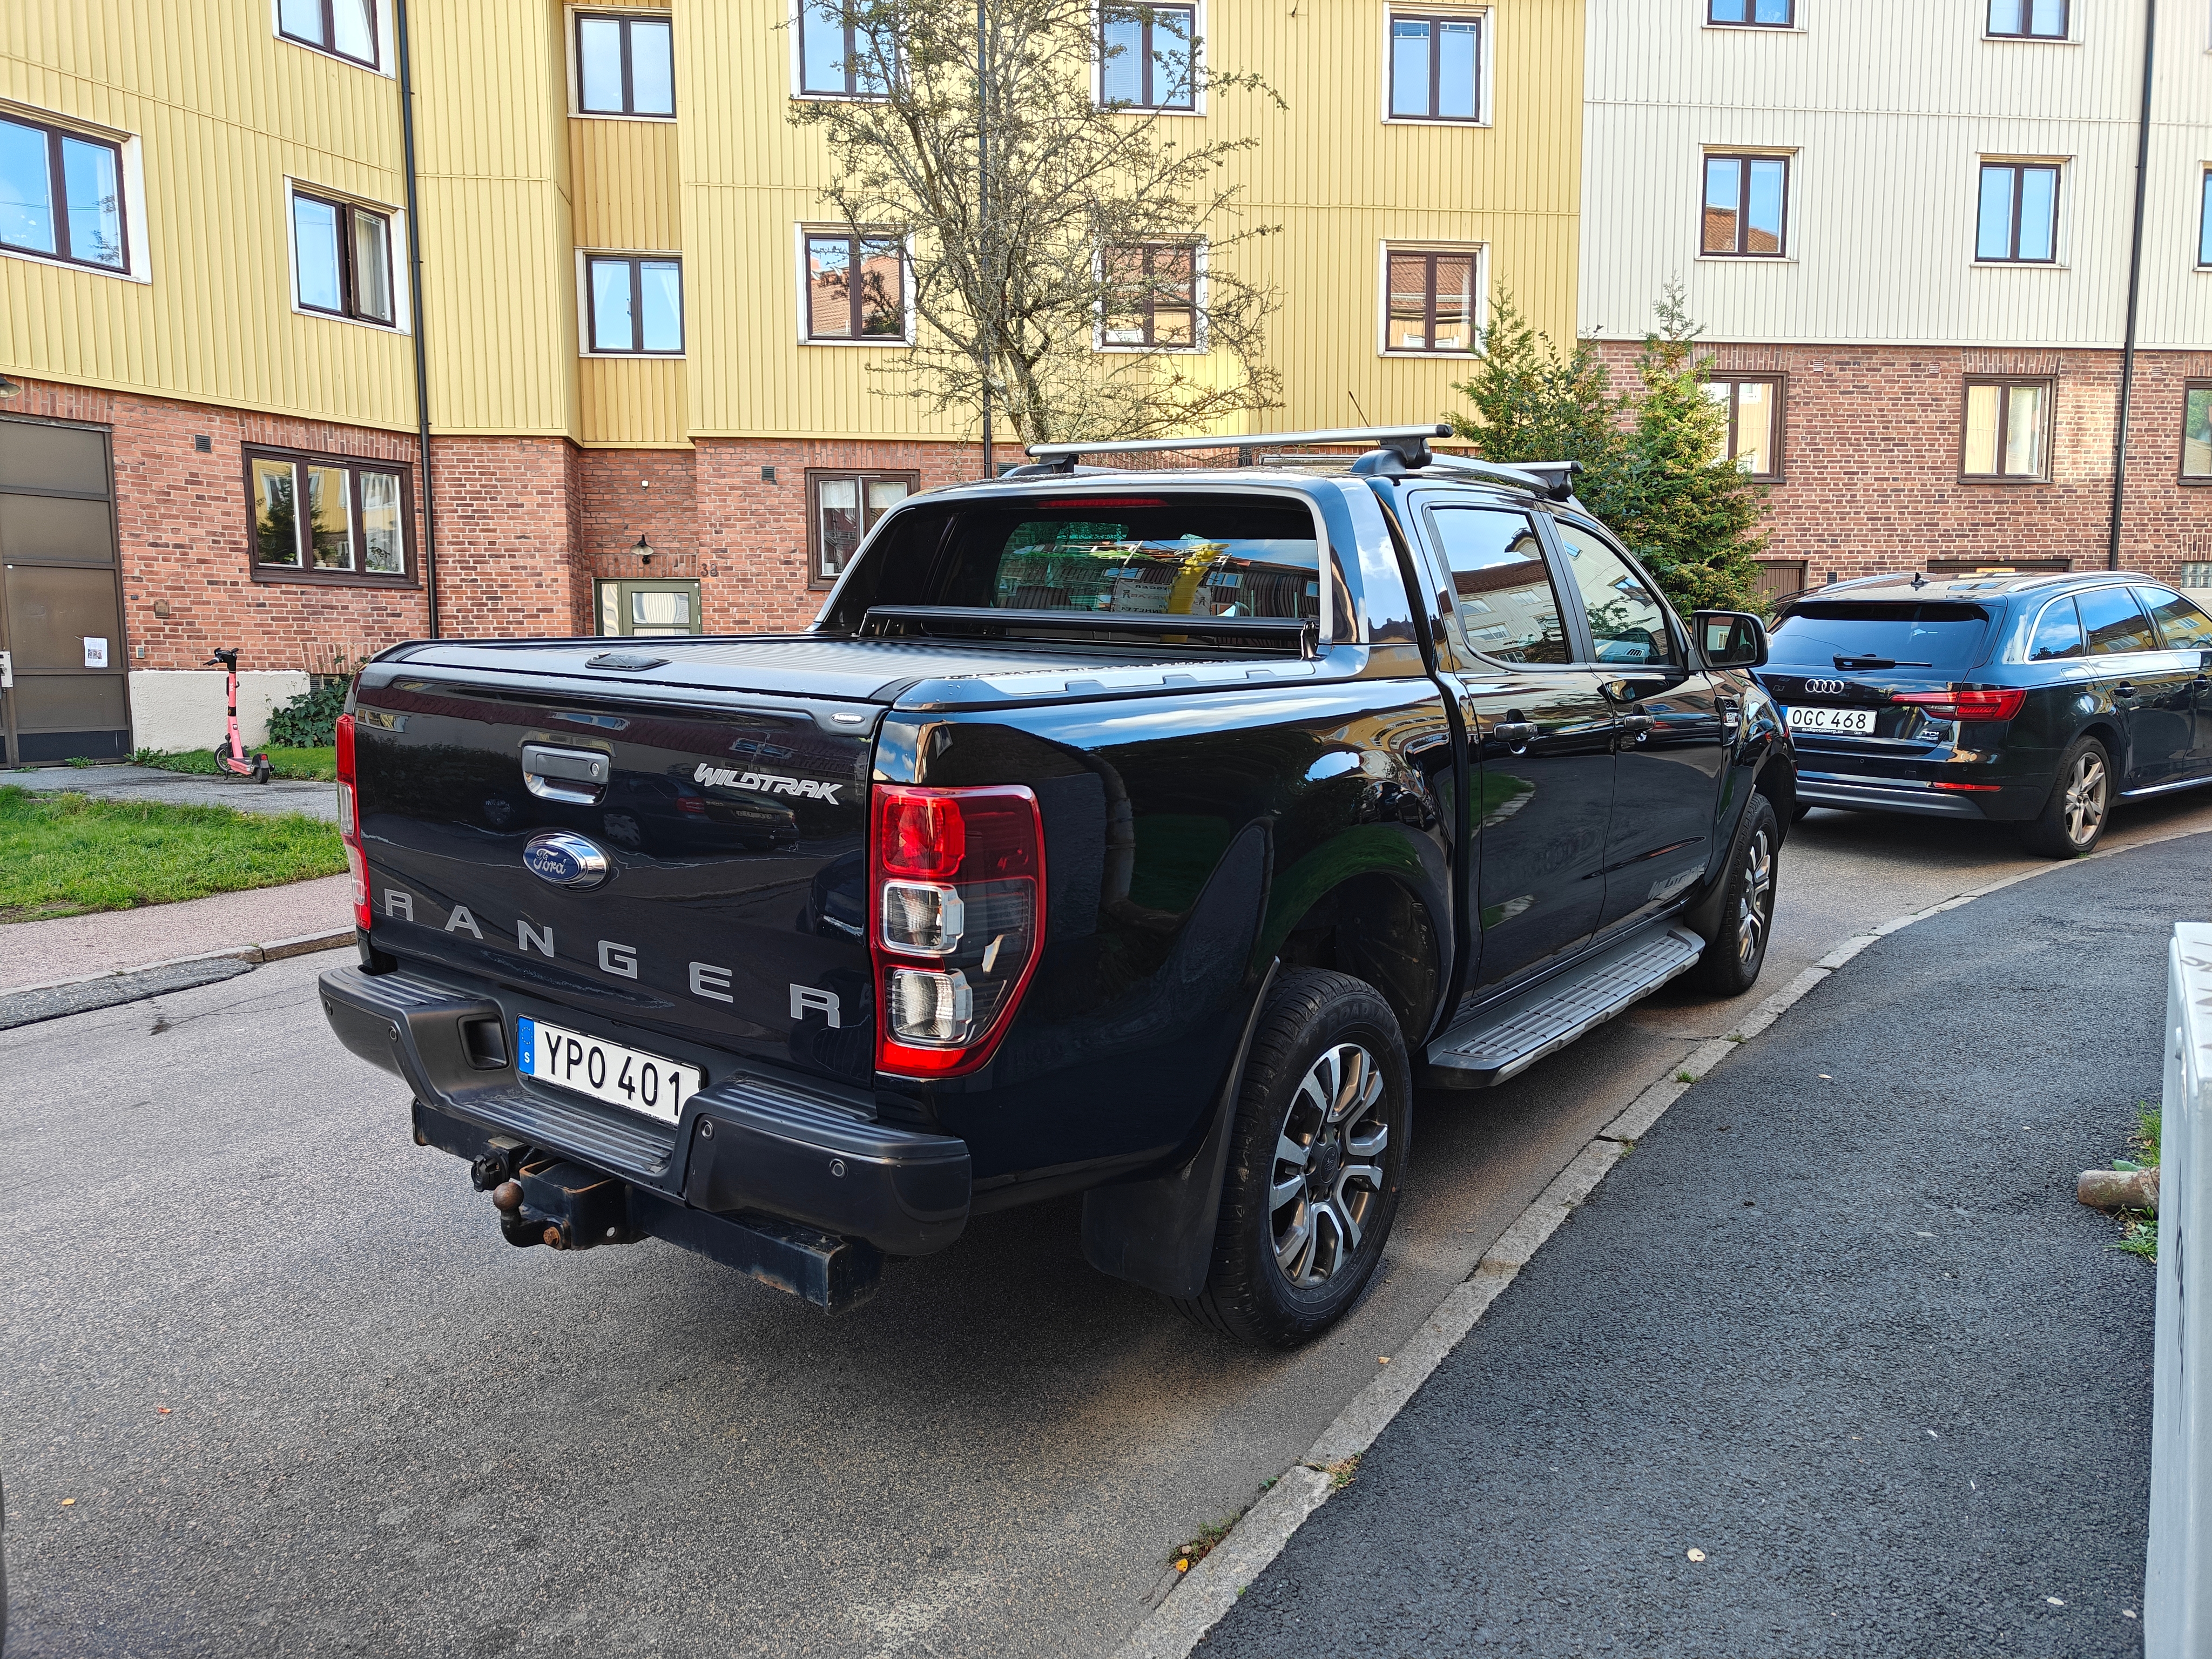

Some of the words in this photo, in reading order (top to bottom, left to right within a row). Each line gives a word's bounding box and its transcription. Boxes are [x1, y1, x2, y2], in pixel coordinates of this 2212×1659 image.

[700, 563, 718, 576] 38
[1792, 710, 1826, 726] OGC
[1831, 711, 1866, 729] 468
[694, 763, 843, 805] WILDTRAK
[534, 848, 567, 875] Ford
[384, 888, 840, 1029] RANGER
[524, 1051, 531, 1063] S
[545, 1031, 605, 1089] YPO
[618, 1055, 680, 1116] 401
